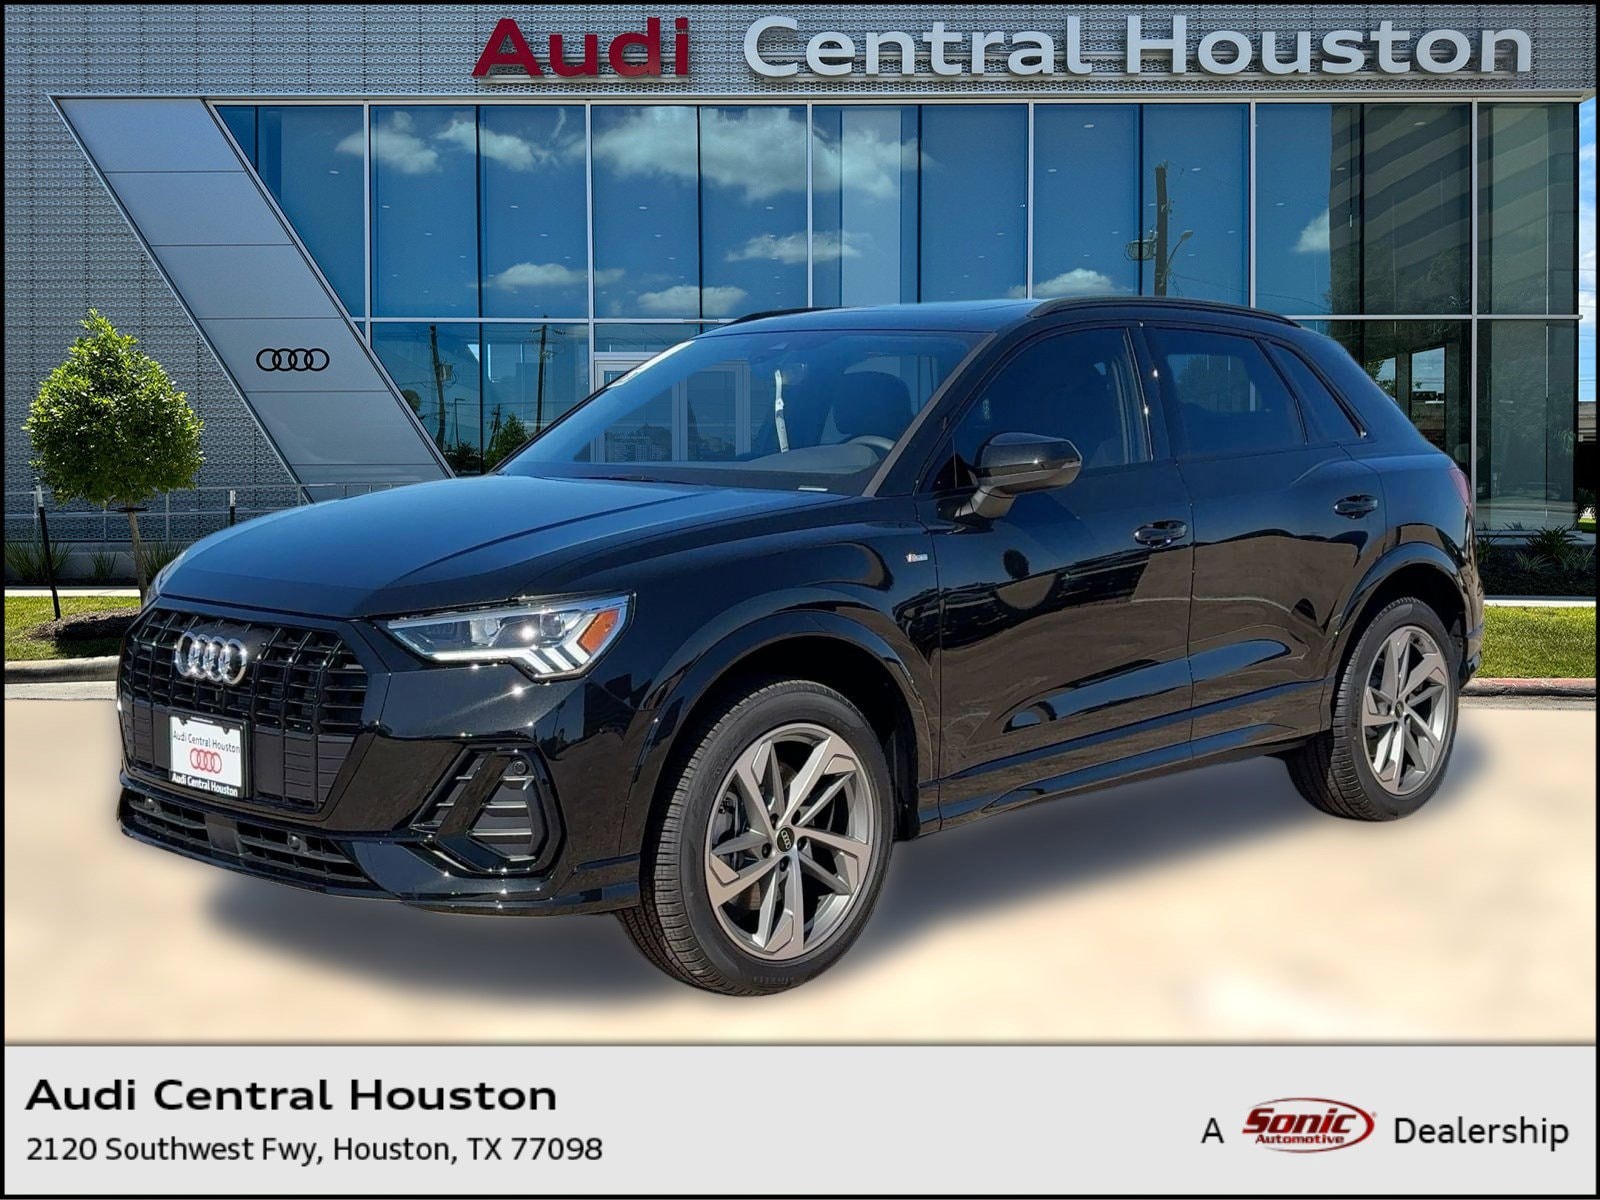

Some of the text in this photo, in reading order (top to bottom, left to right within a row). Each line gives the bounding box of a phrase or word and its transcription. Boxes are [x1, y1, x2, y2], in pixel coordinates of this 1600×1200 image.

[471, 15, 1532, 79] Audi Central Houston
[173, 730, 240, 753] Audi Central Houston
[172, 773, 238, 797] Audi Central Houston
